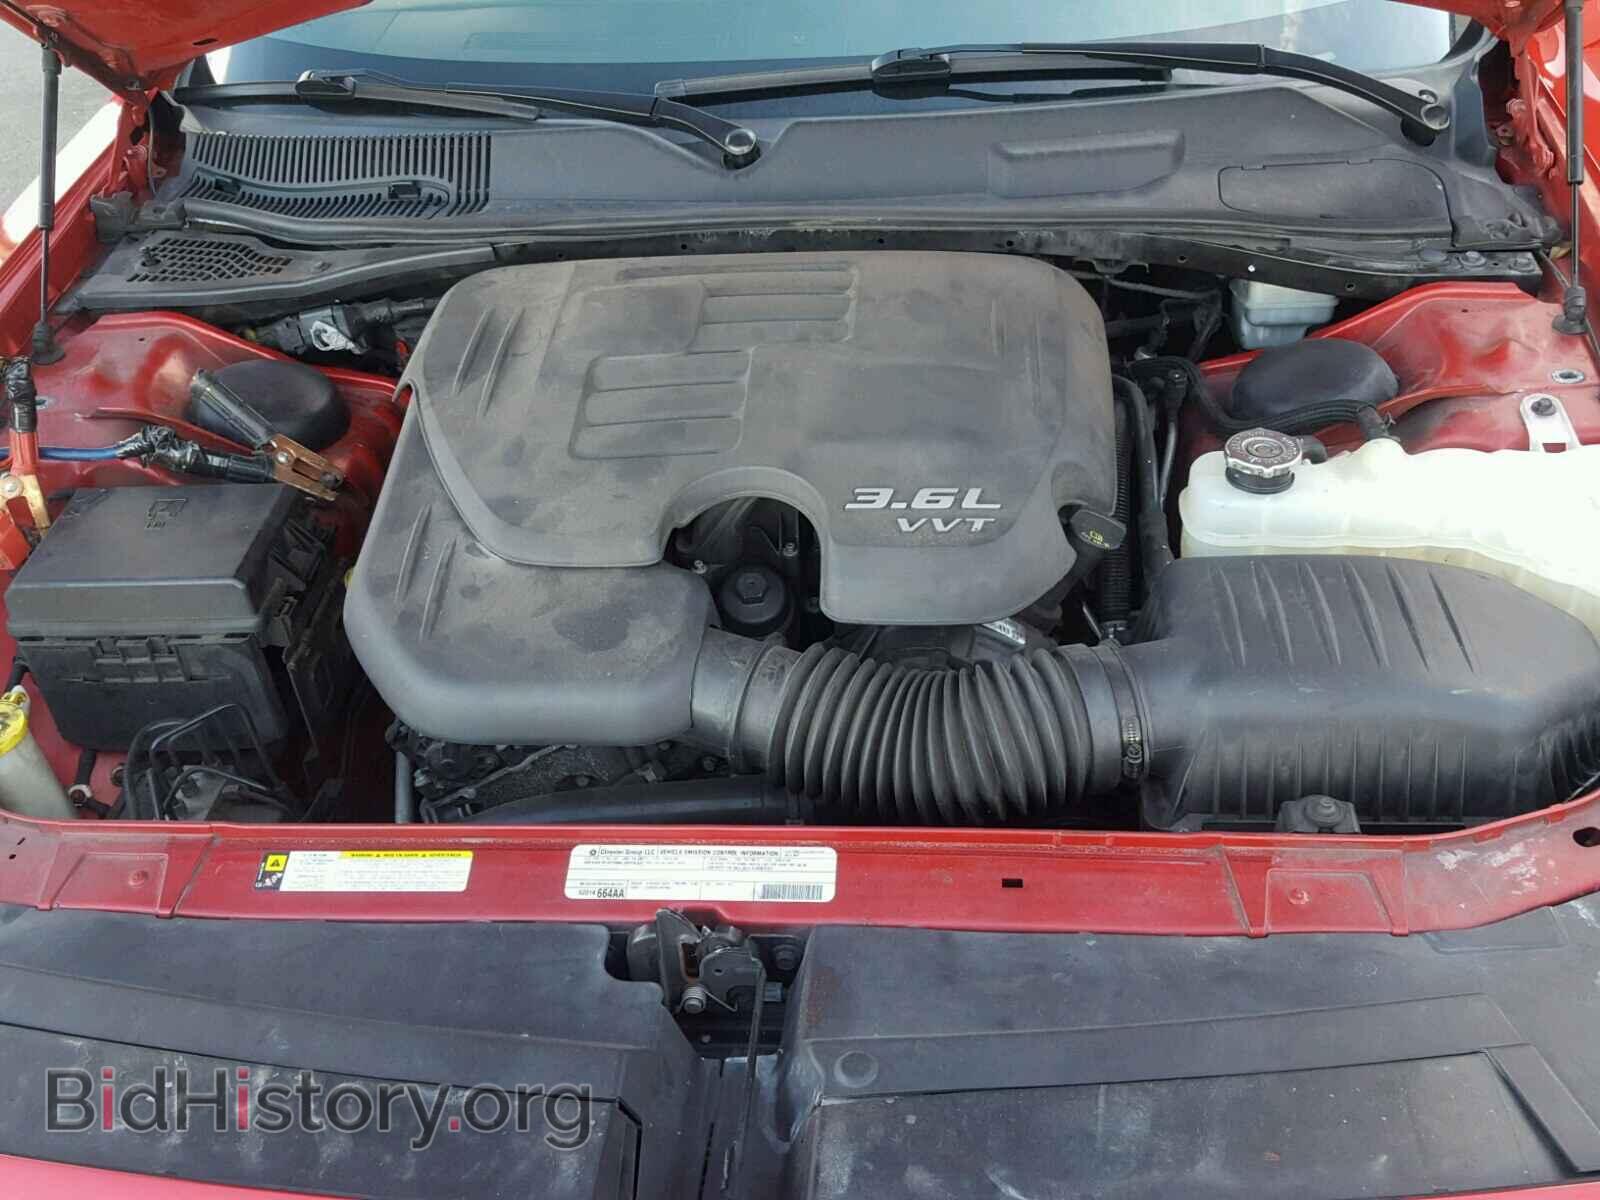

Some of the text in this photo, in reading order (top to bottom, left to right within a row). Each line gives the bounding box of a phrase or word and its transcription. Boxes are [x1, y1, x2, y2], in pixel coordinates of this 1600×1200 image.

[844, 487, 1001, 510] 3.6L
[897, 517, 996, 533] VVT
[596, 888, 624, 898] 664AA
